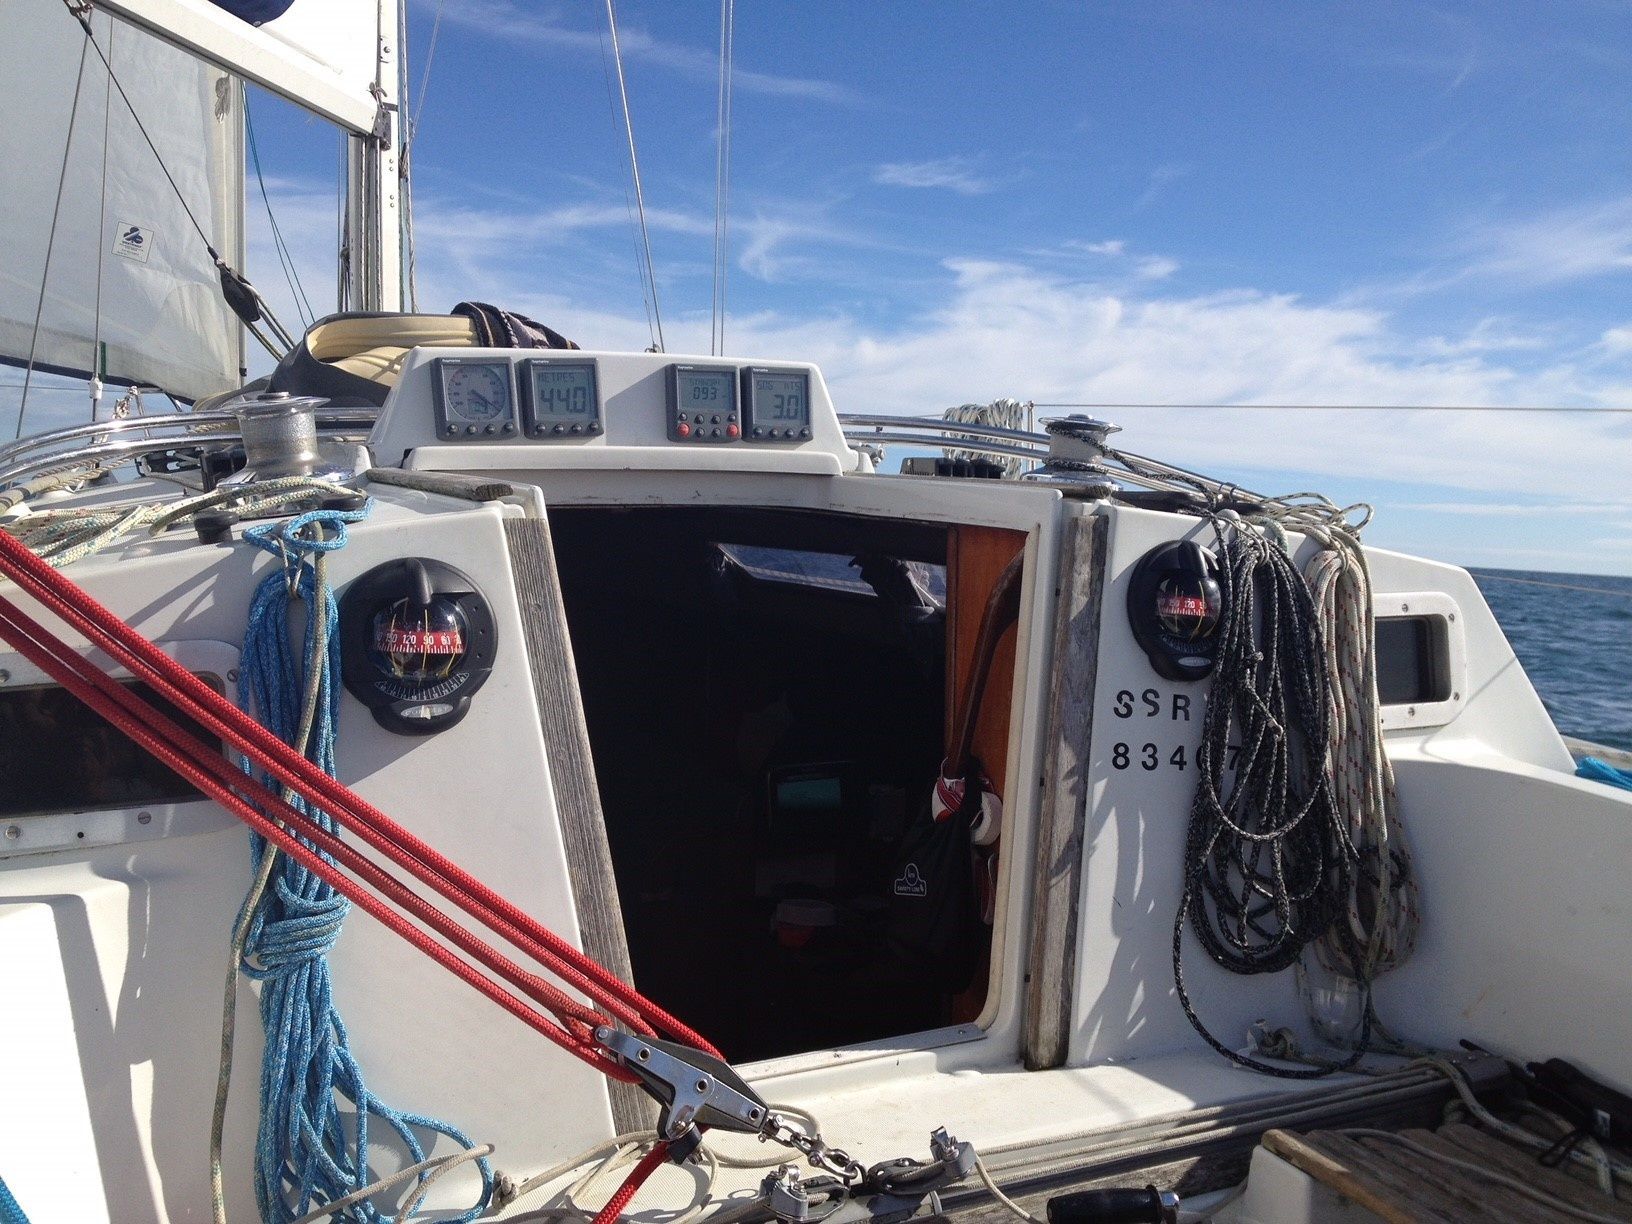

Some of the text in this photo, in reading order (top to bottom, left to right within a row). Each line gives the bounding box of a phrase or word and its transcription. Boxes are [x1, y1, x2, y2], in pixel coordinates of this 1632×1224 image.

[693, 386, 718, 400] 093
[403, 635, 416, 644] 120
[423, 635, 434, 645] 90
[1113, 689, 1191, 721] SSR
[1112, 742, 1240, 771] 8347
